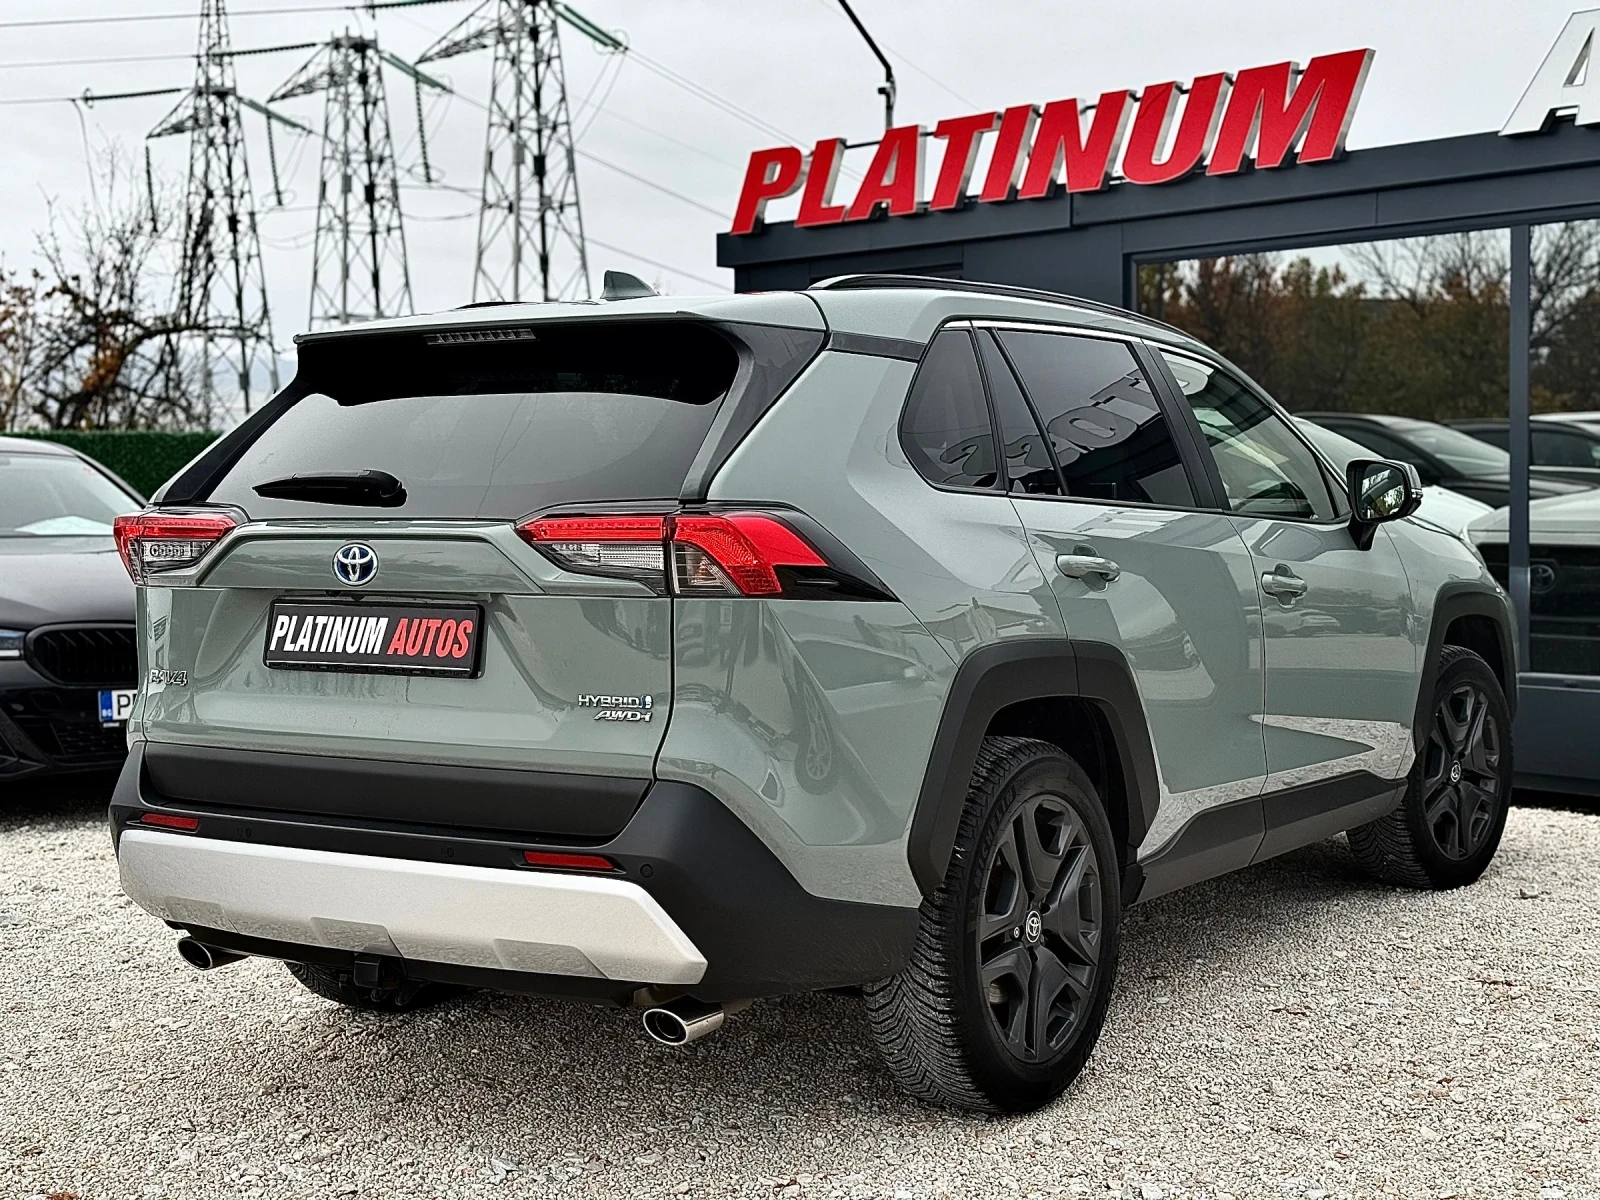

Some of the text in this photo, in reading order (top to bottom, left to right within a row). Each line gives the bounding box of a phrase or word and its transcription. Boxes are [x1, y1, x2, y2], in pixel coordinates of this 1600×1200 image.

[730, 8, 1600, 234] PLATINUM A
[269, 614, 473, 658] PLATINUM AUTOS
[148, 668, 188, 686] RAV4
[578, 694, 640, 708] HYBRID
